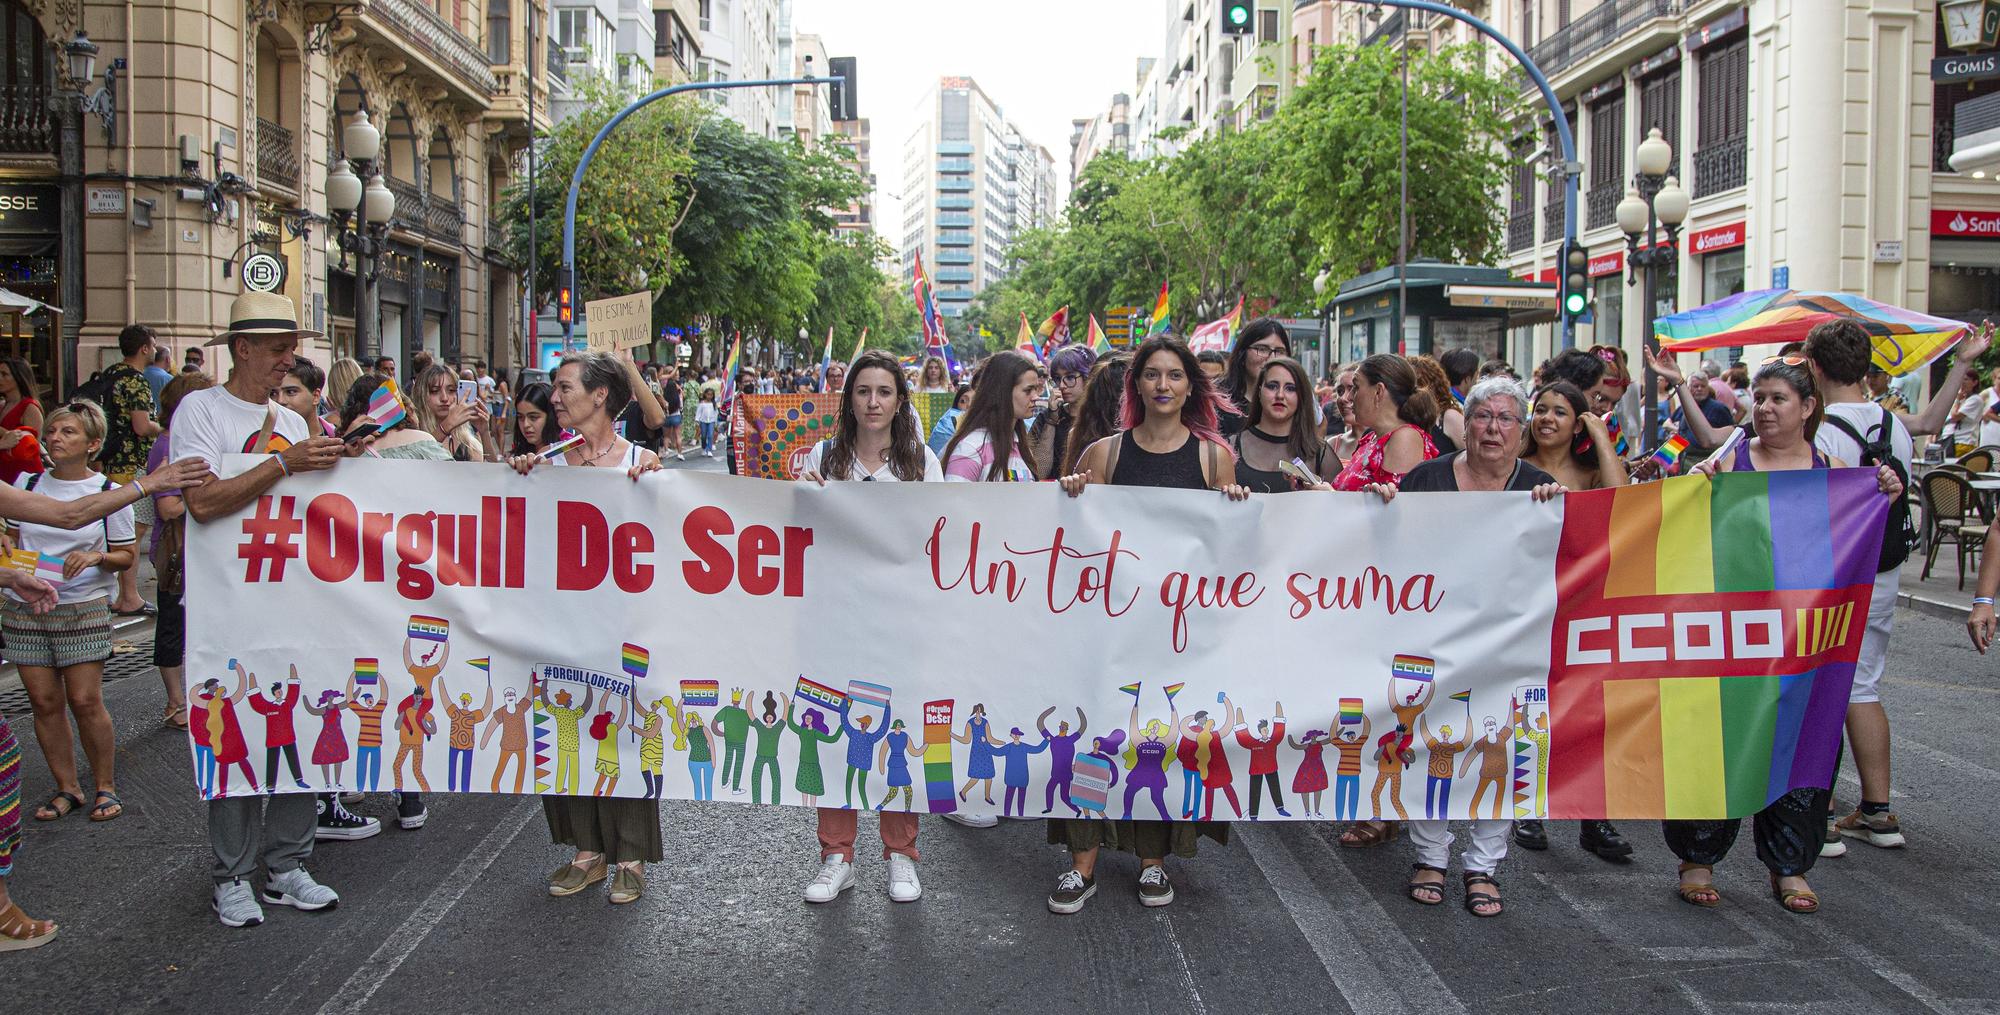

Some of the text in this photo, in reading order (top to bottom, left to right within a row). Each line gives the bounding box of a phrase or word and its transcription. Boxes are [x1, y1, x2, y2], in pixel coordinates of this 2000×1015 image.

[1704, 230, 1737, 249] Santander
[253, 264, 272, 283] B
[562, 307, 571, 321] 14
[605, 302, 634, 318] ESTIME
[638, 299, 645, 313] A
[238, 493, 814, 600] #Orgull De Ser
[925, 516, 1445, 654] Un tot que suma
[409, 622, 448, 635] CCOO
[1566, 608, 1784, 666] CCOO
[1394, 662, 1434, 675] CCOO
[543, 666, 630, 697] #ORGULLODESER
[685, 690, 715, 698] CCOO
[799, 683, 842, 706] CCOO
[1524, 688, 1546, 702] #OR
